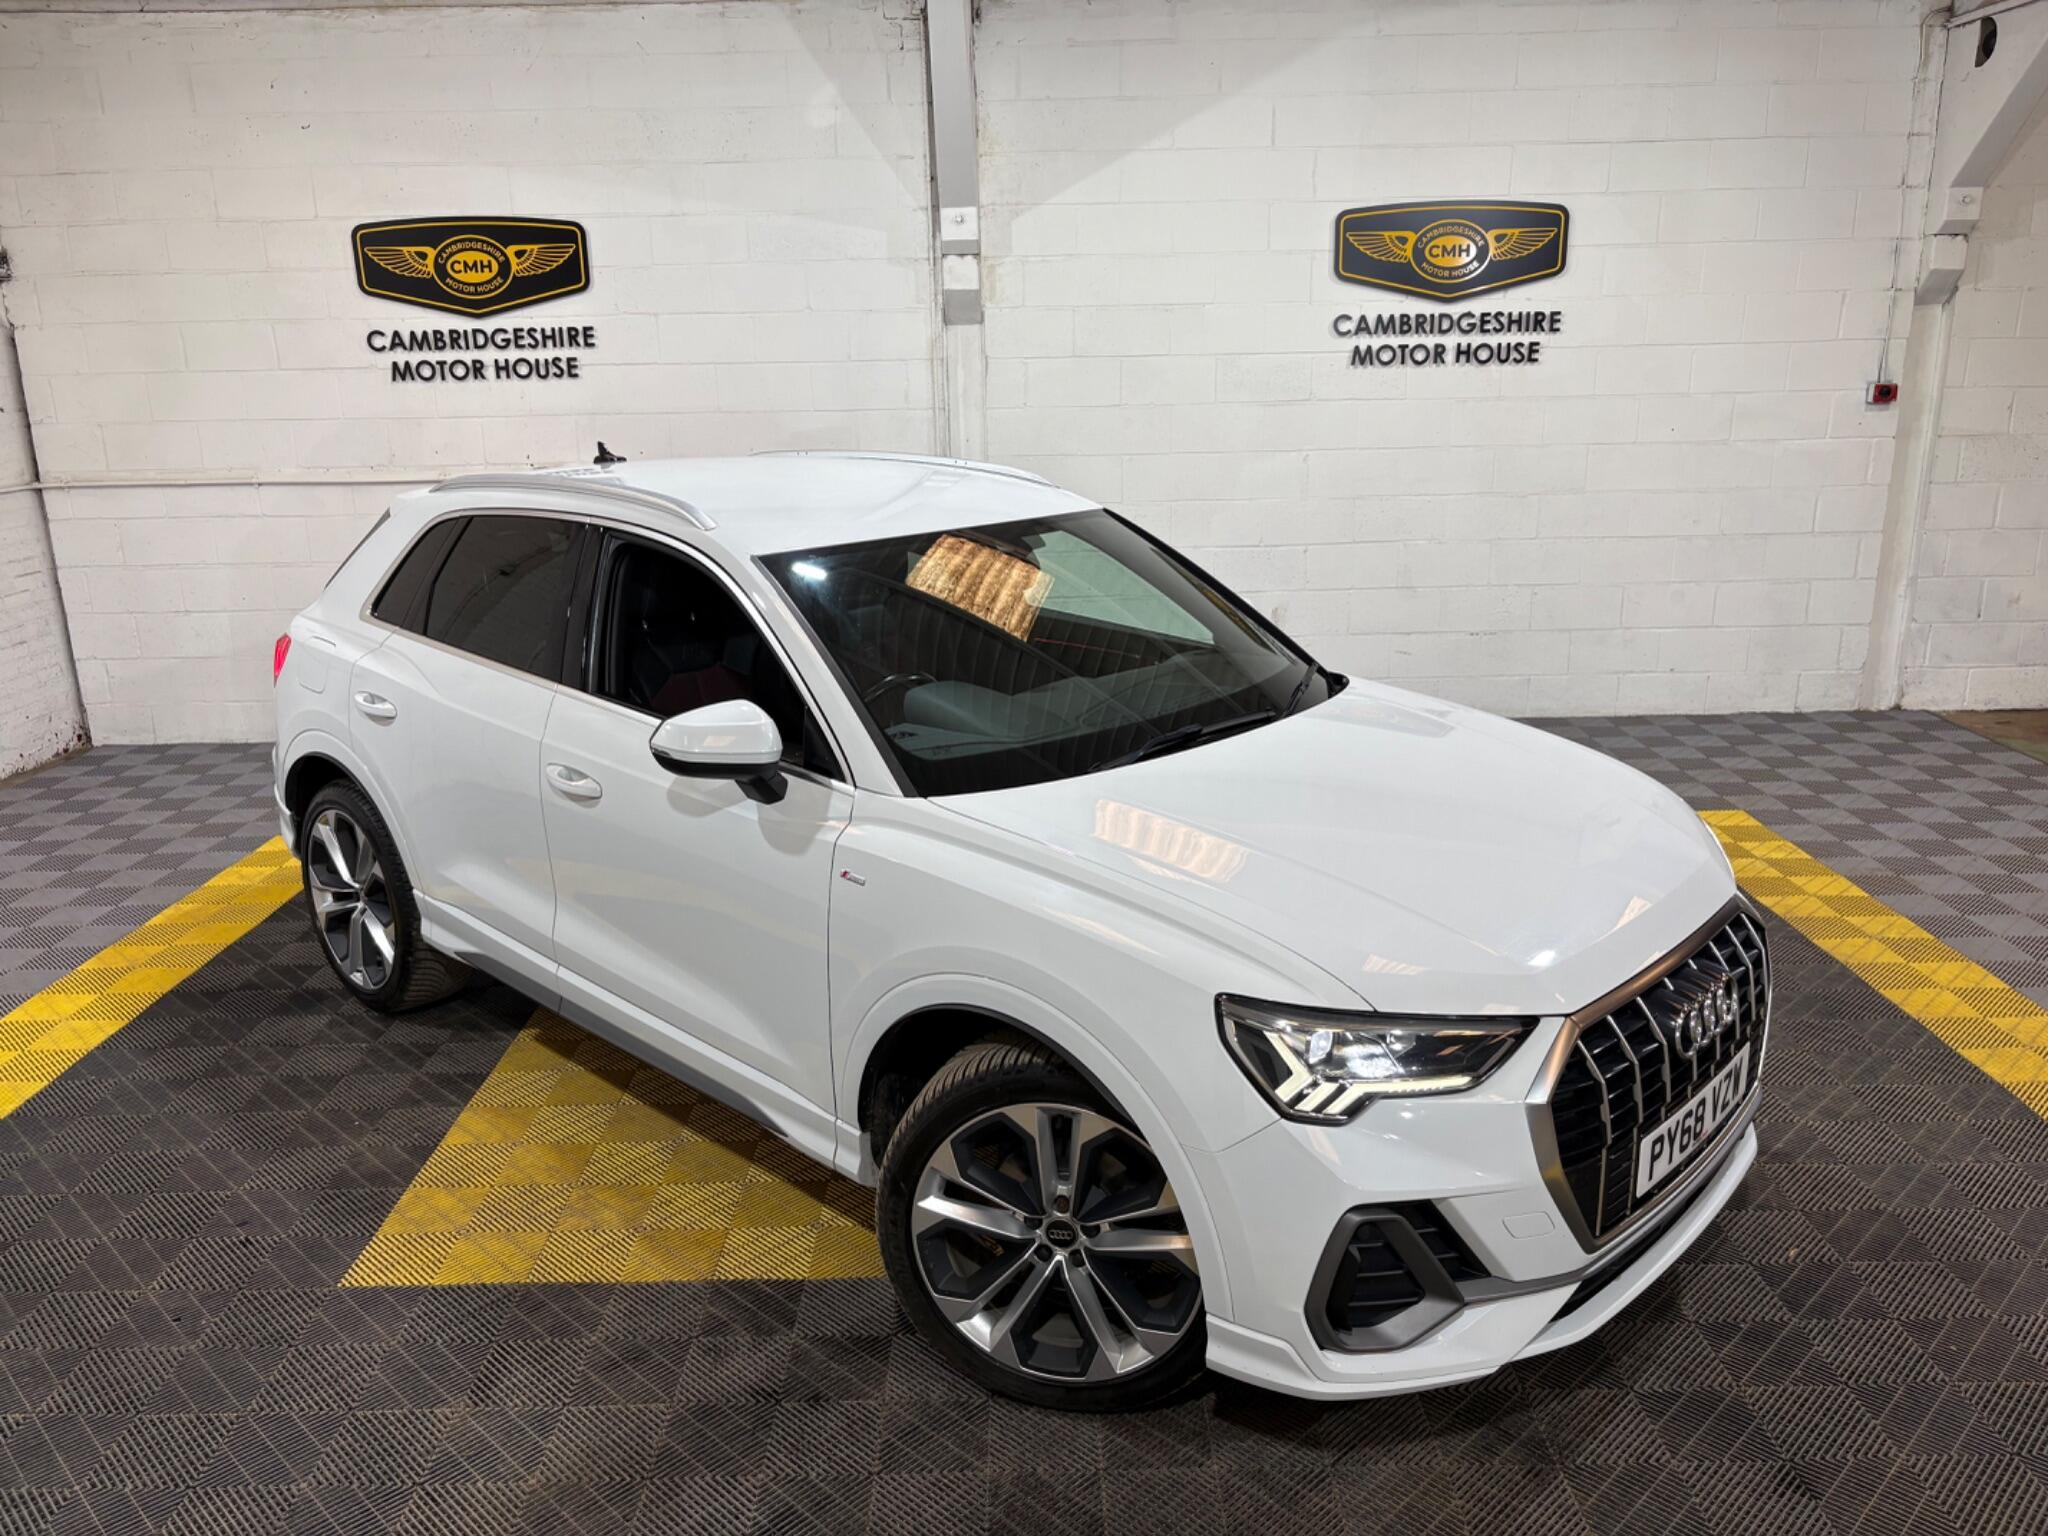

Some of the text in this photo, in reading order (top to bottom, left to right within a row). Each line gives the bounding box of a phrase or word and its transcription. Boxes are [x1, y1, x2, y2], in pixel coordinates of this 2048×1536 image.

[1417, 225, 1485, 249] CAMBRIDGESHIRE
[438, 241, 506, 264] CAMBRIDGESHIRE
[1428, 243, 1471, 258] CMH
[450, 259, 493, 273] CMH
[1421, 260, 1480, 277] MOTOR HOUSE
[445, 276, 504, 293] MOTOR HOUSE
[1333, 311, 1562, 337] CAMBRIDGESHIRE
[366, 326, 596, 353] CAMBRIDGESHIRE
[1350, 341, 1541, 367] MOTOR HOUSE
[391, 356, 580, 383] MOTOR HOUSE
[1648, 1097, 1706, 1182] PY68
